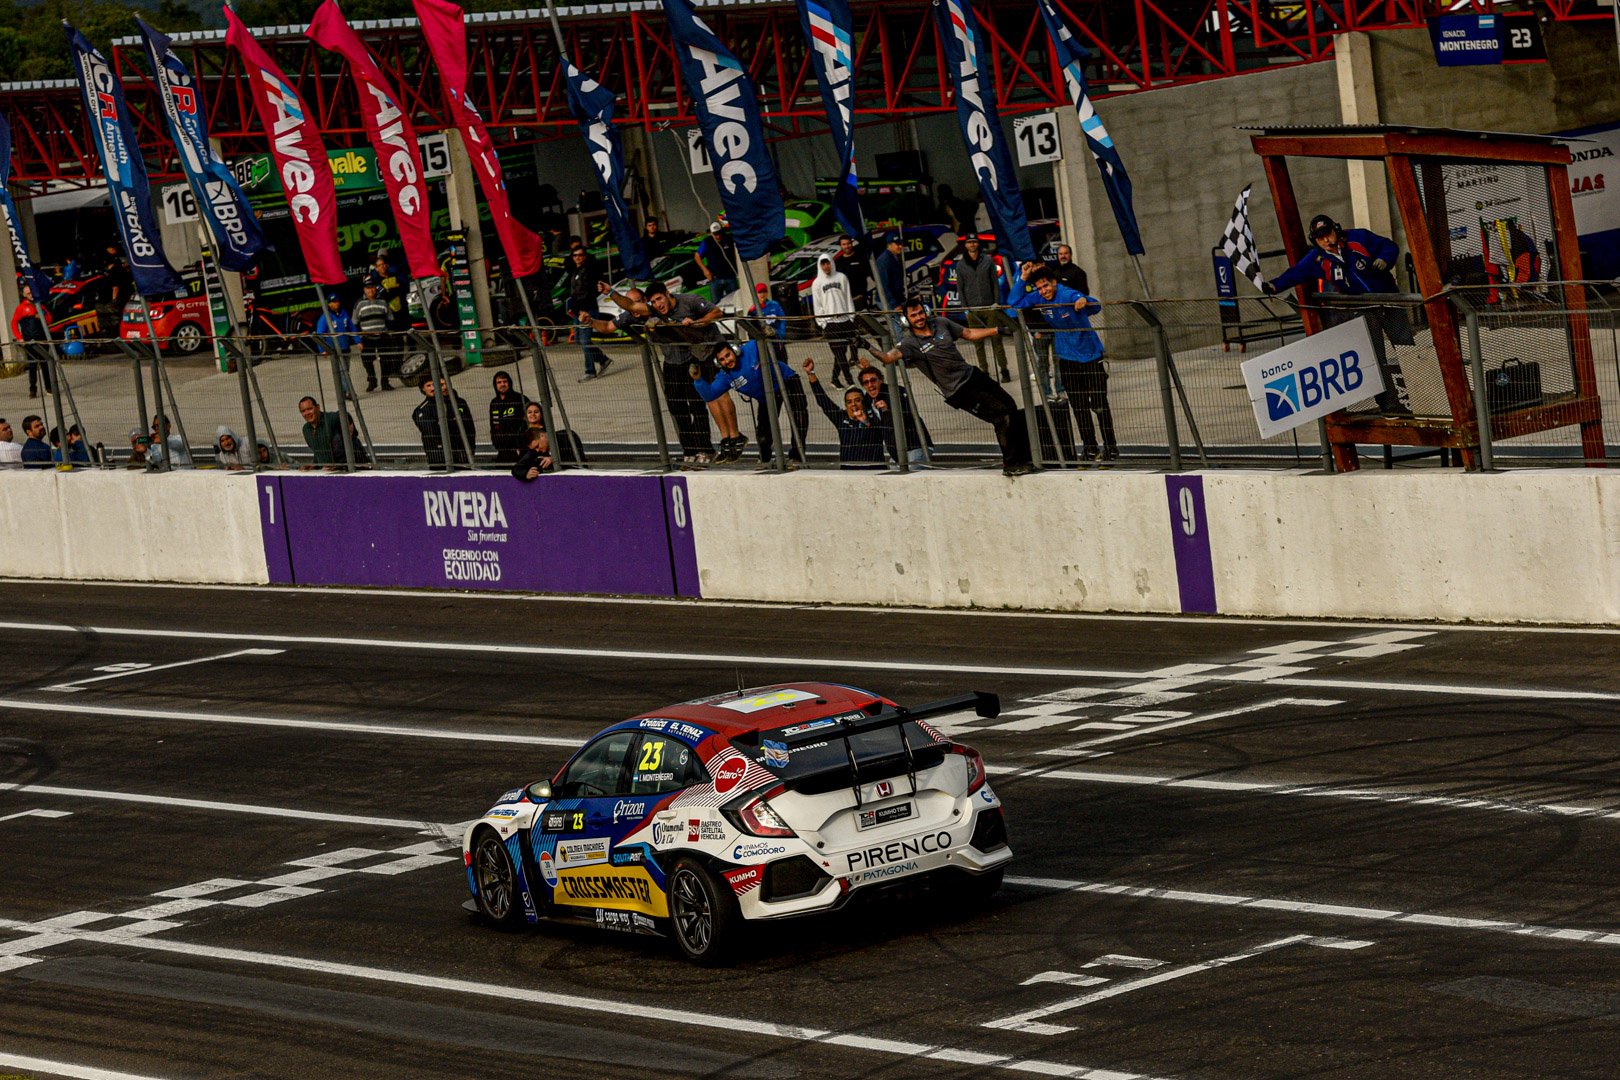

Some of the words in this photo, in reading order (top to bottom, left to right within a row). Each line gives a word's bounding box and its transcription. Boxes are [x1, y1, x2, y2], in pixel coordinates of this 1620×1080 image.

[1442, 29, 1466, 38] IGNACIO
[1510, 28, 1532, 48] 23
[1439, 39, 1499, 52] MONTENEGRO
[1019, 122, 1057, 157] 13
[420, 141, 447, 171] 15
[1571, 174, 1605, 193] JAS
[167, 190, 197, 218] 16
[908, 238, 924, 251] 76
[189, 280, 201, 292] 17
[1261, 360, 1293, 379] banco
[1299, 350, 1363, 408] BRB
[423, 490, 508, 528] RIVERA
[672, 485, 687, 528] 8
[1179, 487, 1196, 536] 9
[467, 529, 478, 542] Sin
[478, 529, 508, 545] fronteras
[442, 548, 481, 561] CRECIENDO
[482, 550, 499, 562] CON
[444, 560, 501, 581] EQUIDAD
[669, 722, 679, 731] EL
[680, 724, 704, 738] TENAZ
[781, 723, 810, 734] TCR
[638, 741, 665, 771] 23
[717, 769, 738, 780] Claro
[859, 811, 875, 819] TCR
[878, 808, 897, 817] KUMHO
[573, 813, 584, 830] 23
[700, 820, 722, 828] RASTREO
[743, 842, 768, 851] VIVAMOS
[743, 847, 785, 858] COMODORO
[847, 831, 951, 871] PIRENCO
[728, 869, 757, 885] KUMHO
[863, 861, 918, 881] PATAGONIA
[561, 876, 652, 904] CROSSMASTER
